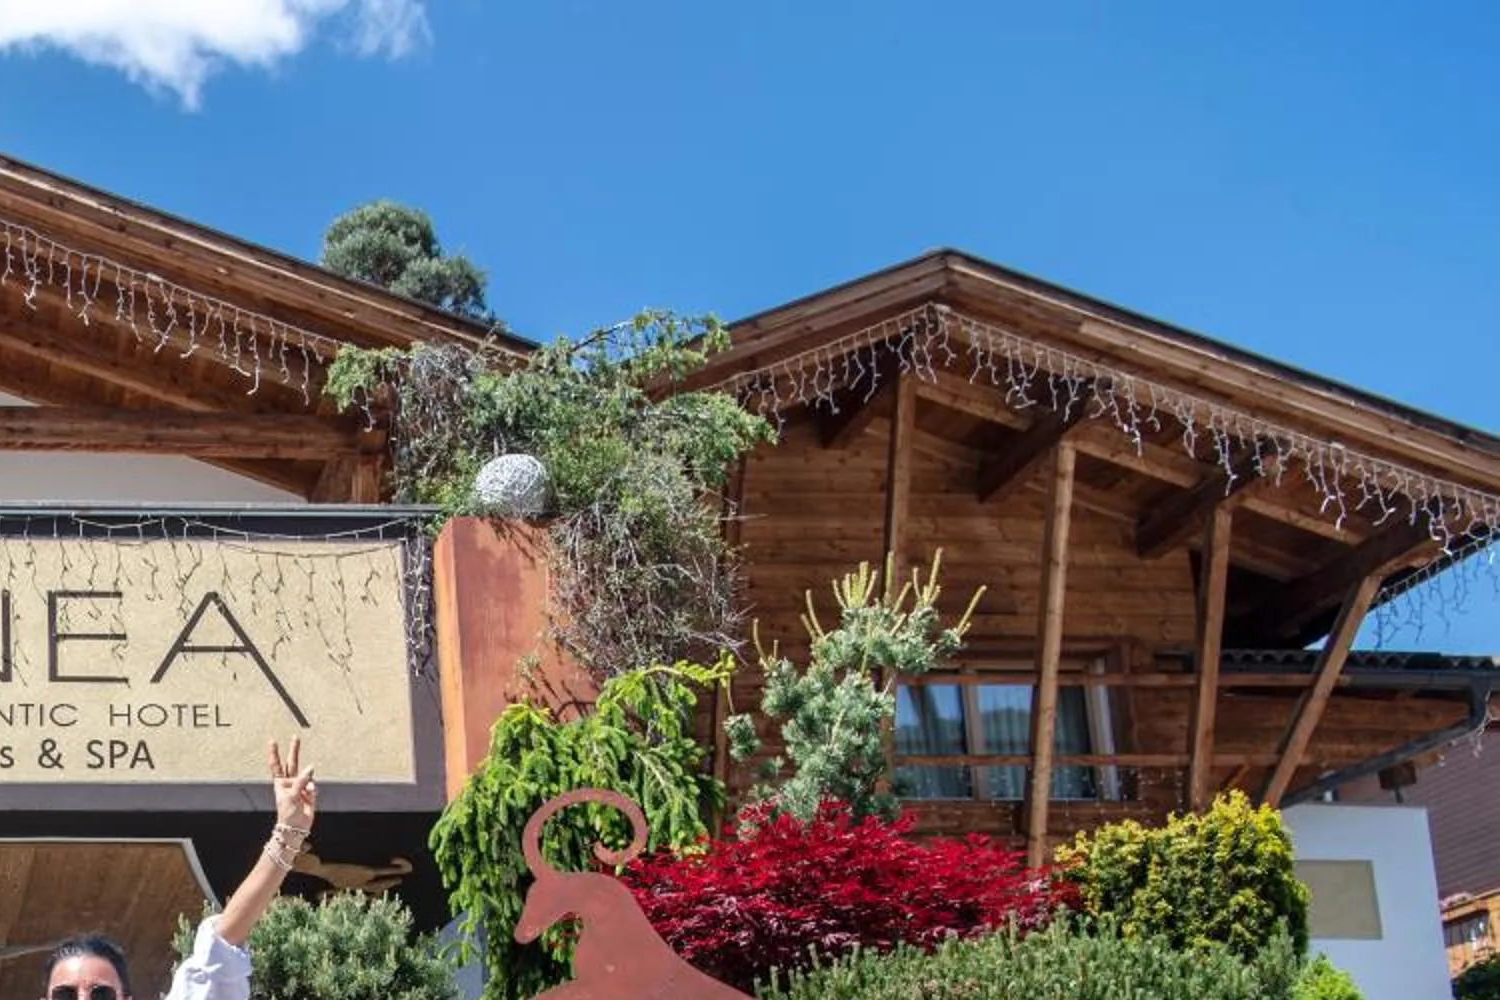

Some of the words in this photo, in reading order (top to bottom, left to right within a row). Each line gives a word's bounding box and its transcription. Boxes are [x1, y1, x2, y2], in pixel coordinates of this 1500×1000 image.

[109, 703, 232, 728] HOTEL
[37, 739, 64, 770] &
[86, 739, 156, 770] SPA
